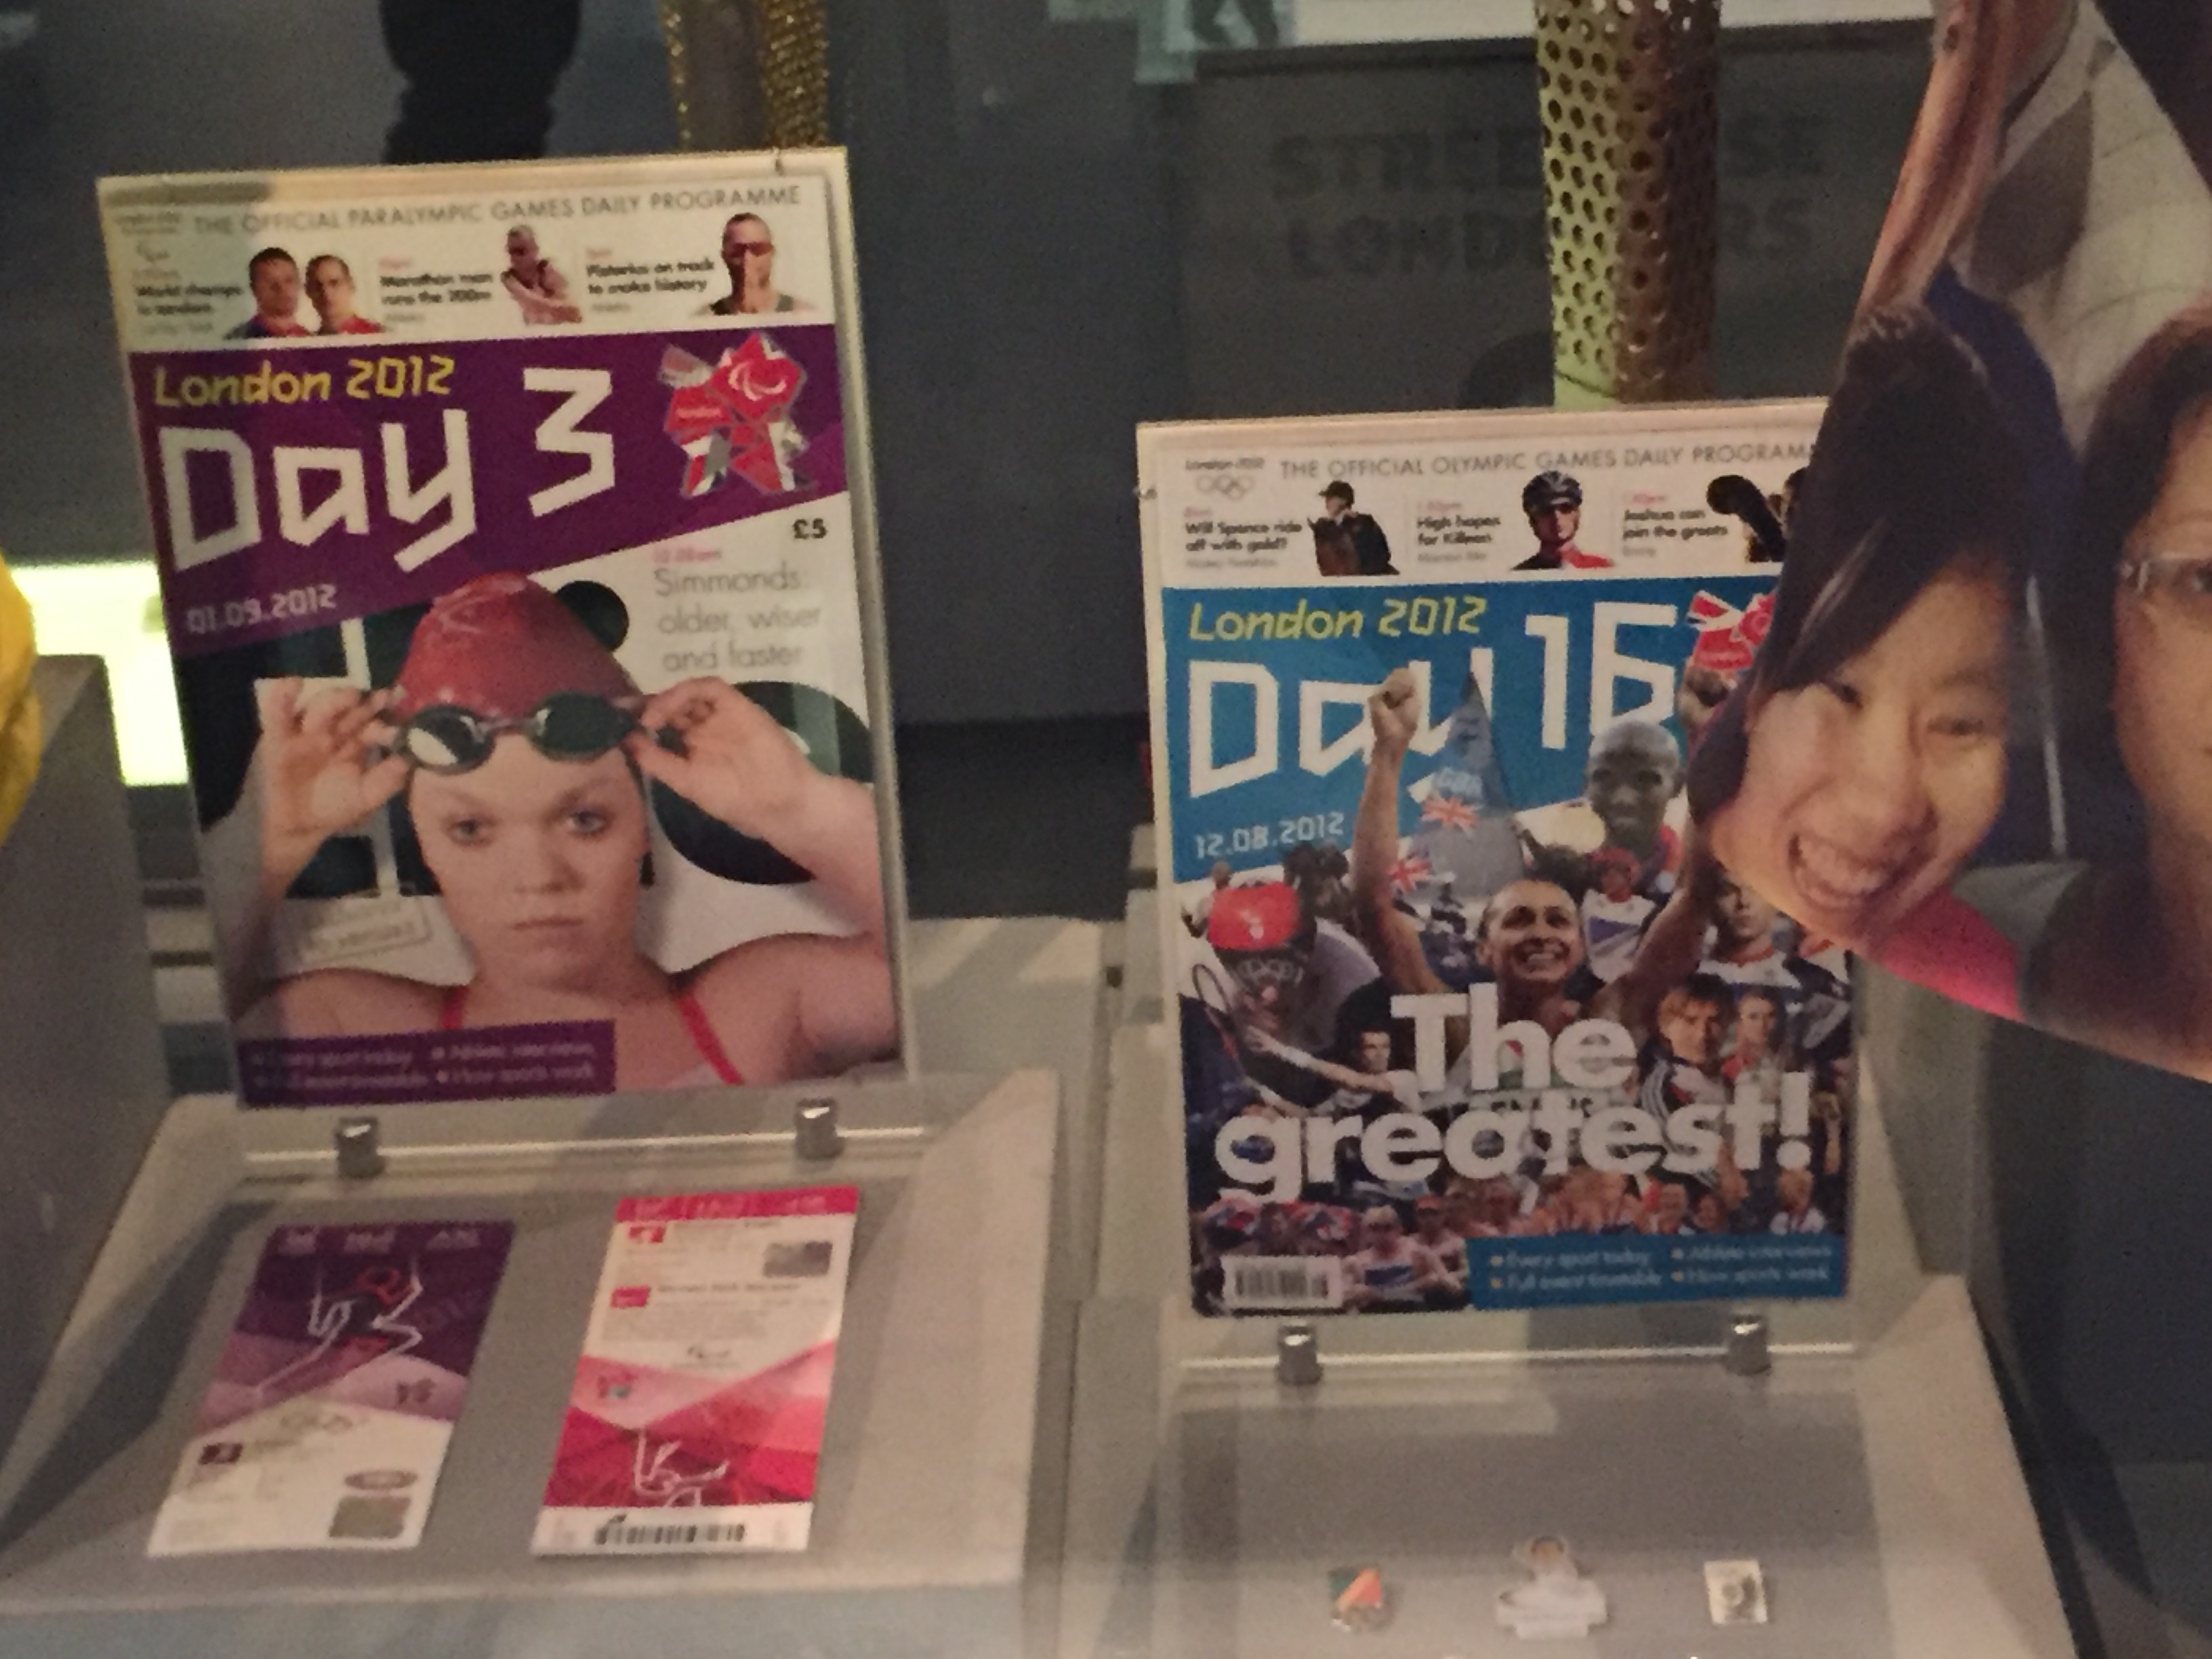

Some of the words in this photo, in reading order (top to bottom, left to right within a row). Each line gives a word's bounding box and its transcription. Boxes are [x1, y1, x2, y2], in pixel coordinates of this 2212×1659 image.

[194, 216, 232, 234] THE
[242, 211, 338, 233] OFFICIAL
[349, 203, 483, 228] PARALYMPIC
[491, 198, 574, 220] GAMES
[581, 194, 640, 214] DAILY
[649, 185, 800, 211] PROGRAMME
[677, 255, 715, 272] track
[588, 283, 603, 294] to
[654, 278, 708, 293] history
[155, 360, 332, 406] London
[347, 354, 455, 401] 2012
[159, 408, 477, 572] Day
[523, 367, 615, 517] 3
[1279, 459, 1318, 480] THE
[1328, 457, 1424, 477] OFFICIAL
[1430, 452, 1527, 475] OLYMPIC
[1535, 449, 1616, 470] GAMES
[1624, 447, 1683, 467] DAILY
[1692, 443, 1816, 463] PROGRAM
[792, 517, 827, 540] £5
[1417, 516, 1452, 532] High
[1455, 514, 1501, 530] hopes
[1417, 533, 1439, 546] for
[1654, 525, 1677, 537] the
[653, 559, 802, 598] Simmonds
[186, 581, 337, 634] 01.09.2012
[747, 605, 821, 629] wiser
[1189, 598, 1364, 641] London
[1377, 595, 1488, 637] 2012
[662, 640, 718, 672] and
[728, 638, 803, 668] faster
[1189, 647, 1494, 802] Day
[1524, 600, 1679, 751] 16
[1195, 811, 1345, 859] 12.08.2012
[1390, 983, 1637, 1092] The
[1215, 1070, 1812, 1202] greatest!
